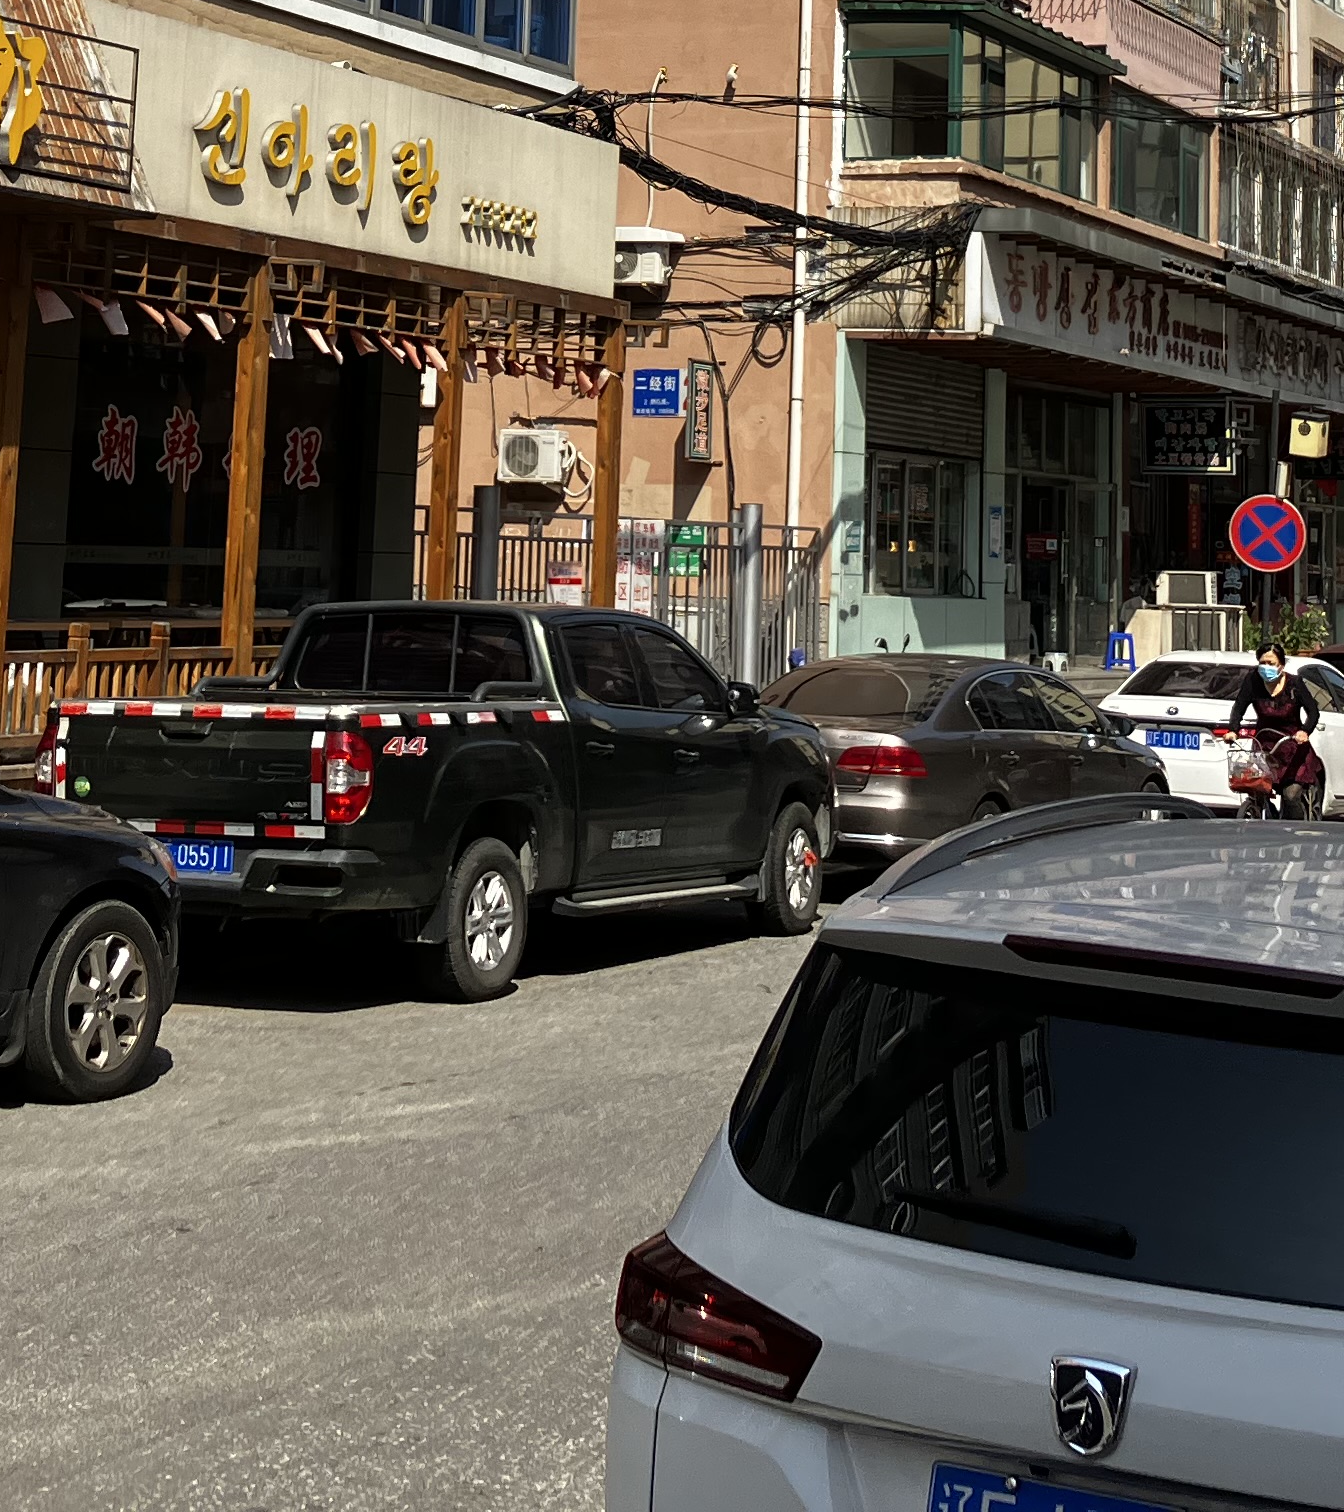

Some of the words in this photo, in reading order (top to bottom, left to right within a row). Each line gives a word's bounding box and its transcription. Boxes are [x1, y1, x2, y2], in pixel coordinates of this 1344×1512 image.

[193, 85, 440, 226] 신아리랑
[91, 403, 323, 492] 朝韩理
